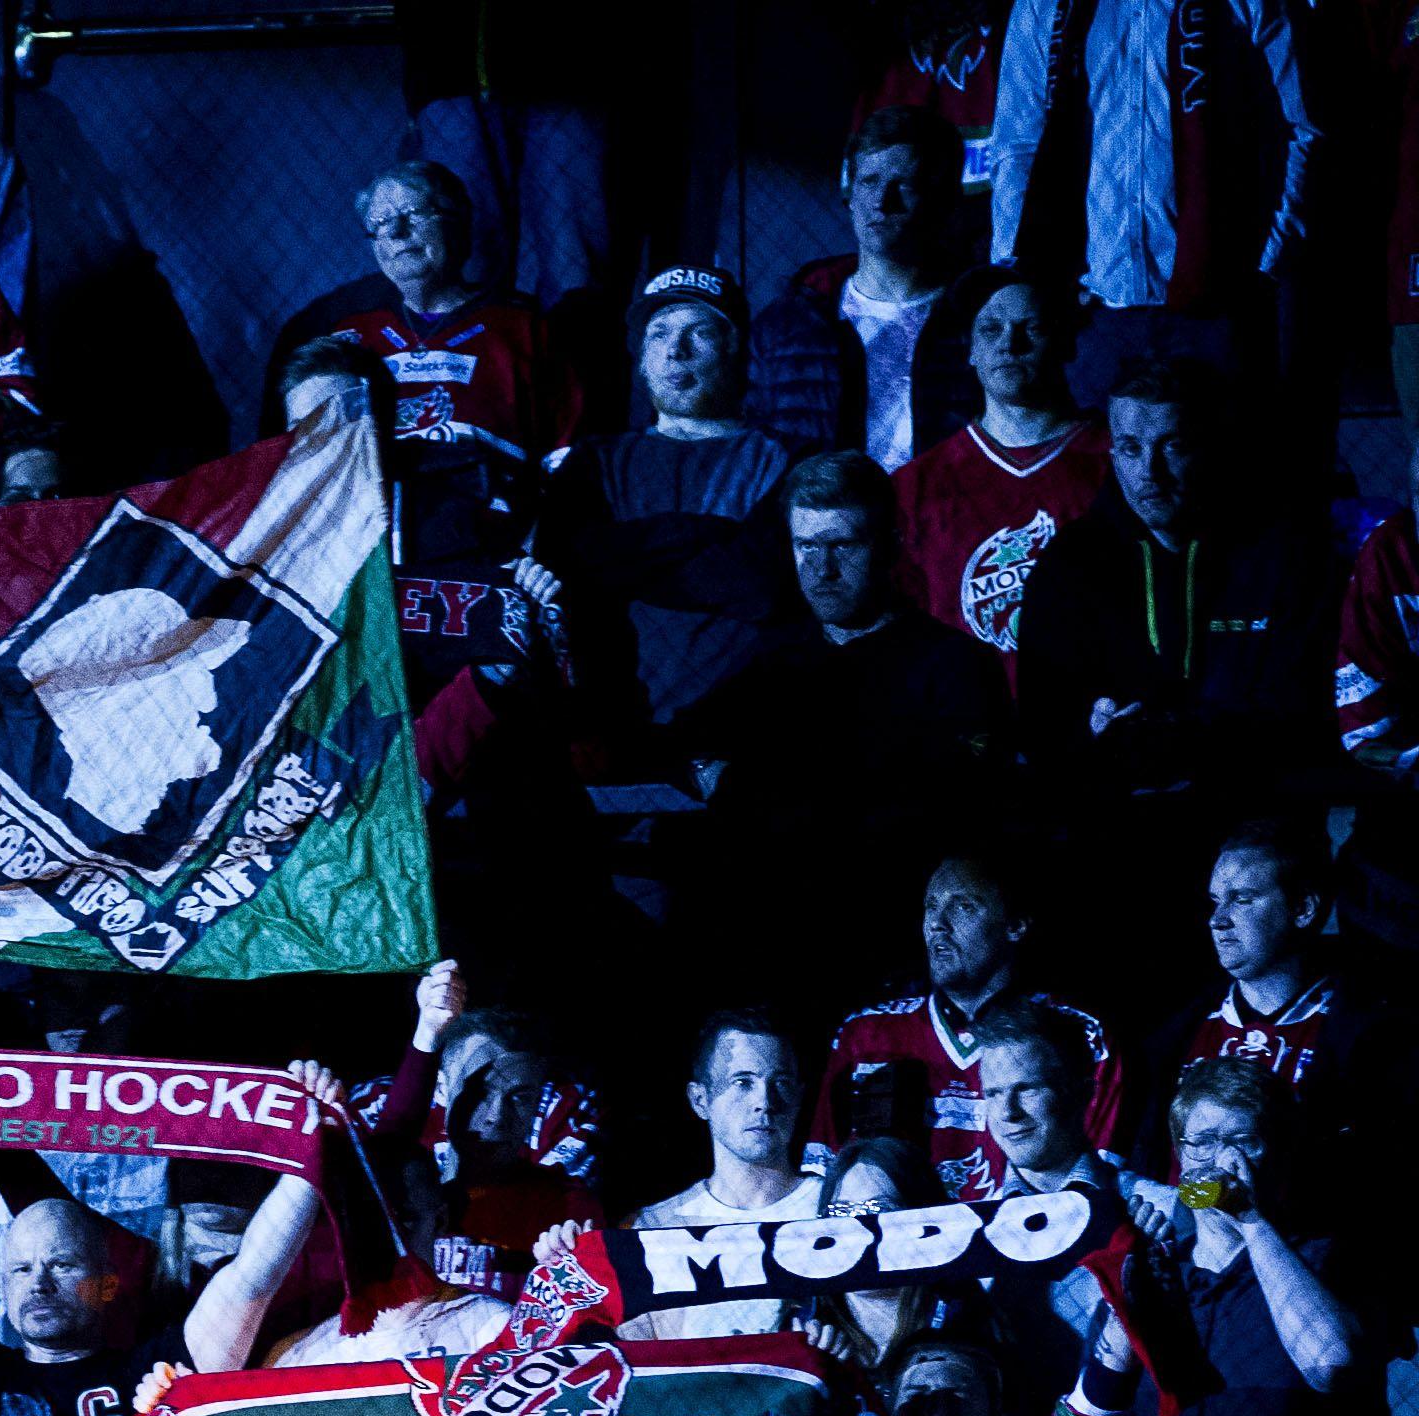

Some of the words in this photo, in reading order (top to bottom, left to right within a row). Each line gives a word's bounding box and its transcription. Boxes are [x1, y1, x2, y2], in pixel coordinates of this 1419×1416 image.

[0, 1117, 73, 1149] EST.
[88, 1119, 159, 1150] 1921
[639, 1191, 1091, 1297] MODO
